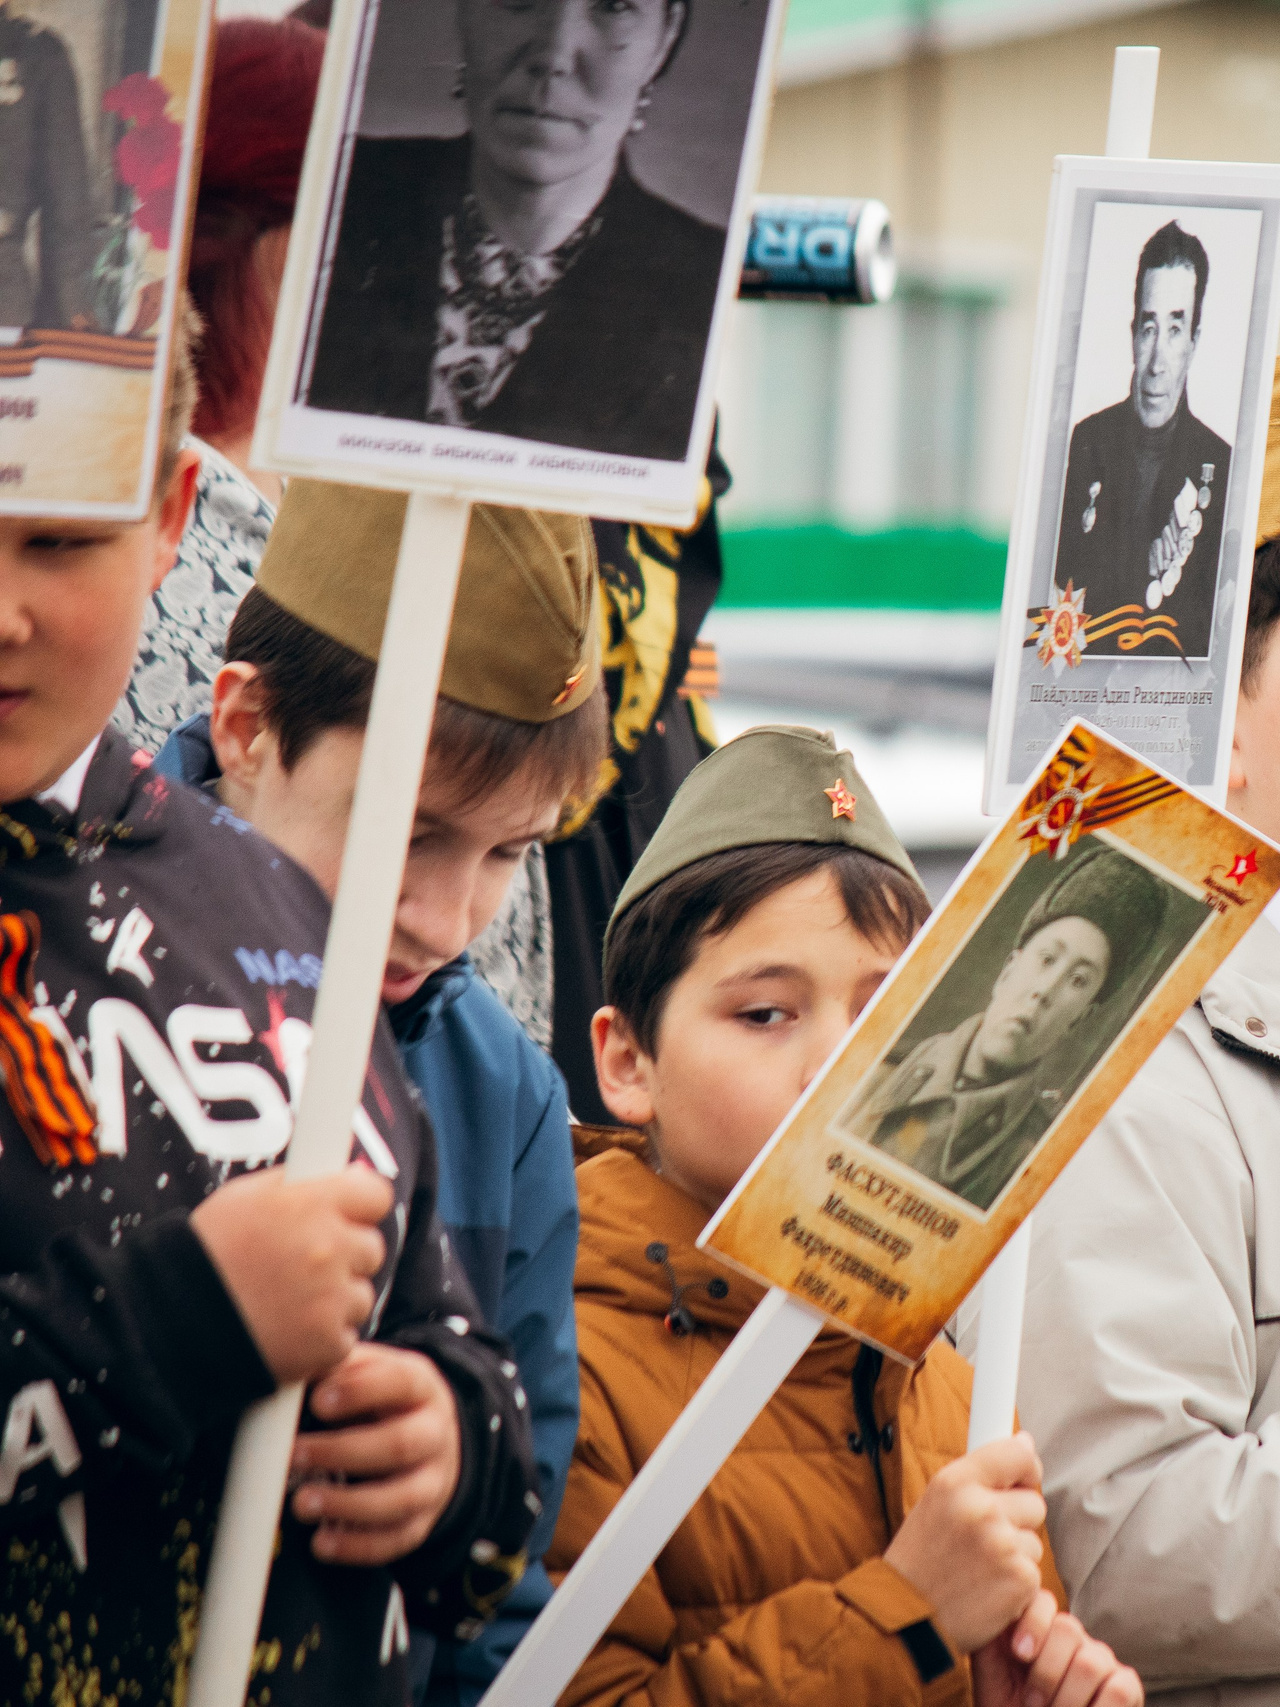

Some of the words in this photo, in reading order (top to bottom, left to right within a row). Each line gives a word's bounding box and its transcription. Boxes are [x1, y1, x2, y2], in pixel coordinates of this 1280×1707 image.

[1029, 683, 1099, 708] Шайдуллин
[1133, 686, 1214, 707] Ризатдинович
[233, 946, 323, 989] NAS
